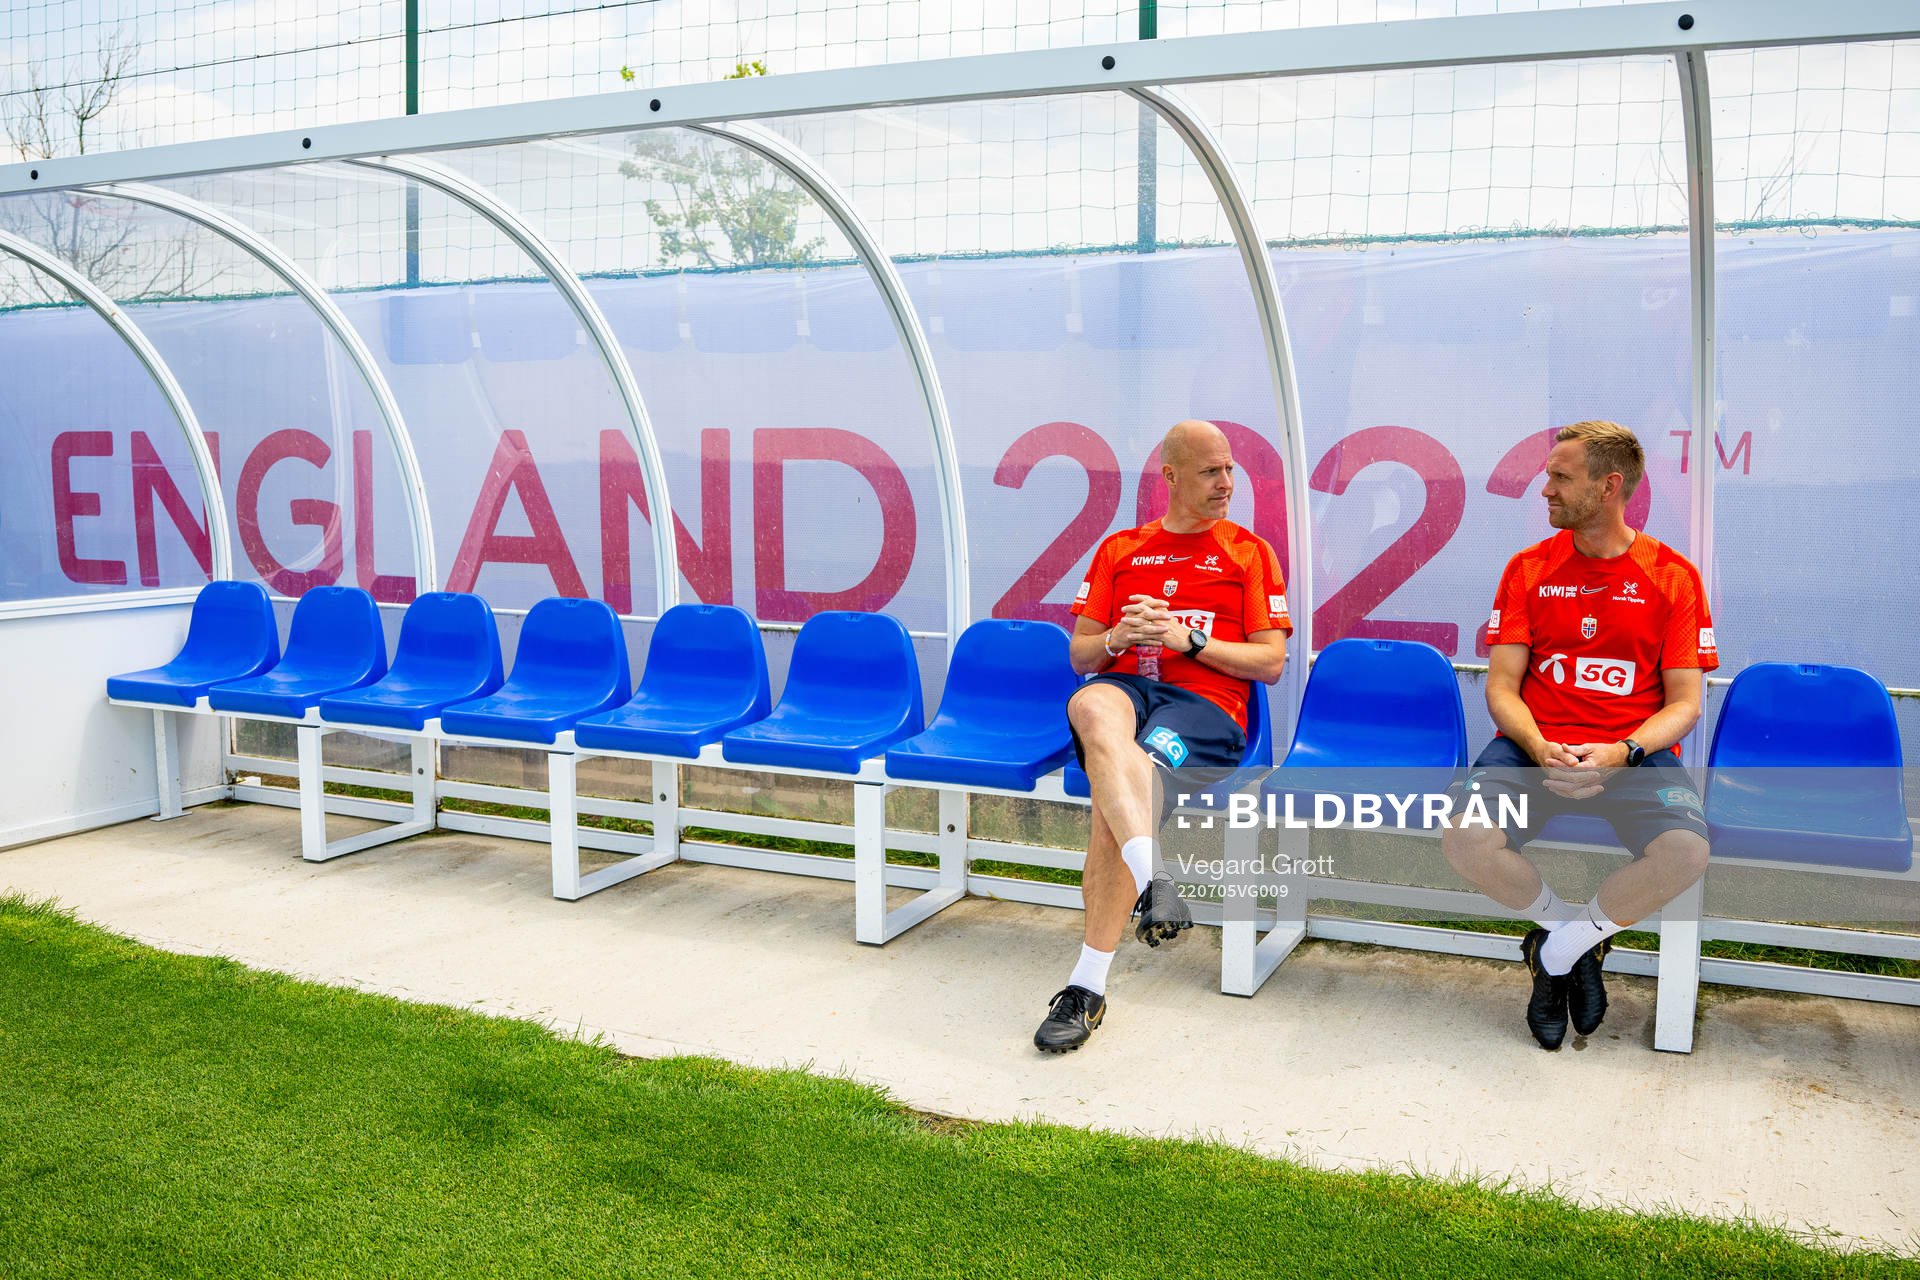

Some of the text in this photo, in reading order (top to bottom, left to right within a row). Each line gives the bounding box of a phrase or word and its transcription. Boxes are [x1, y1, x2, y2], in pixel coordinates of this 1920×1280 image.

[51, 427, 917, 622] ENGLAND
[1131, 556, 1155, 567] KIWI
[1538, 585, 1565, 598] KIWI
[1627, 596, 1645, 604] Tipping
[1581, 664, 1627, 688] 5G
[1152, 731, 1183, 761] 5G
